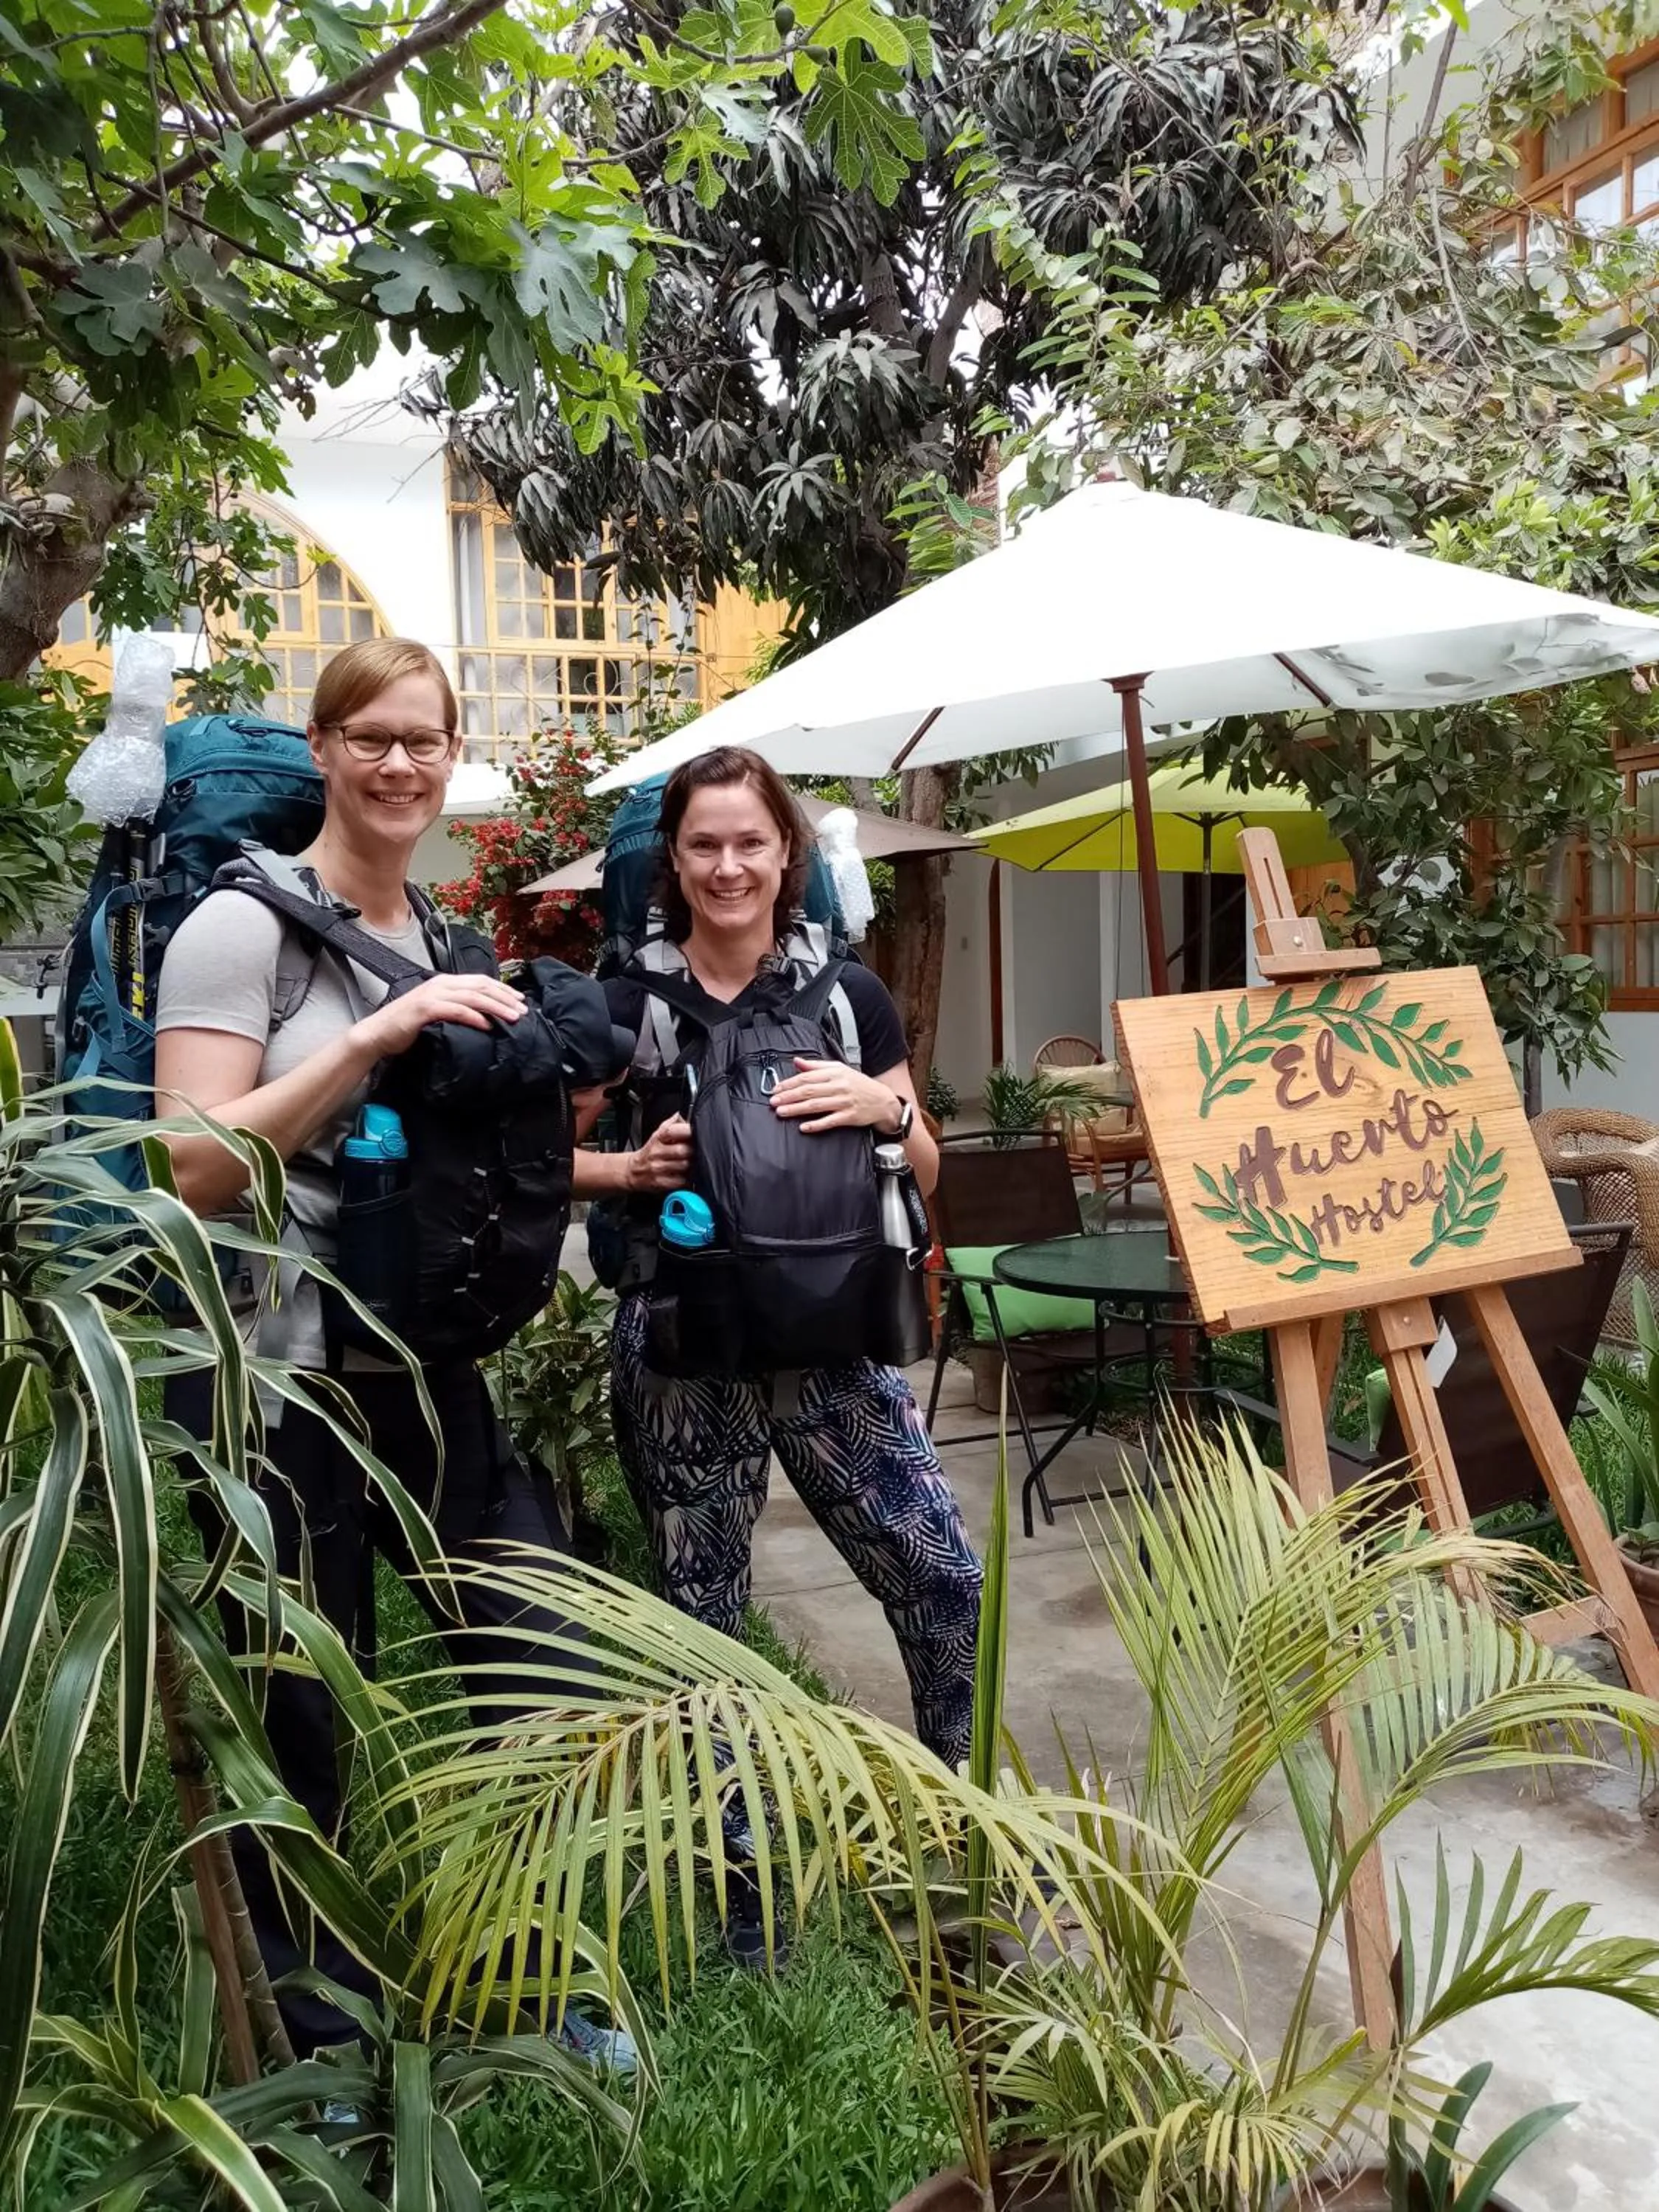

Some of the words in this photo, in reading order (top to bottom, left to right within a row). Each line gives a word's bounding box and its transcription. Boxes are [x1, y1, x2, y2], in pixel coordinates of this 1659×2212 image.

[1270, 1029, 1355, 1109] El
[1234, 1088, 1460, 1209] Huerto
[1309, 1161, 1447, 1247] Hostel
